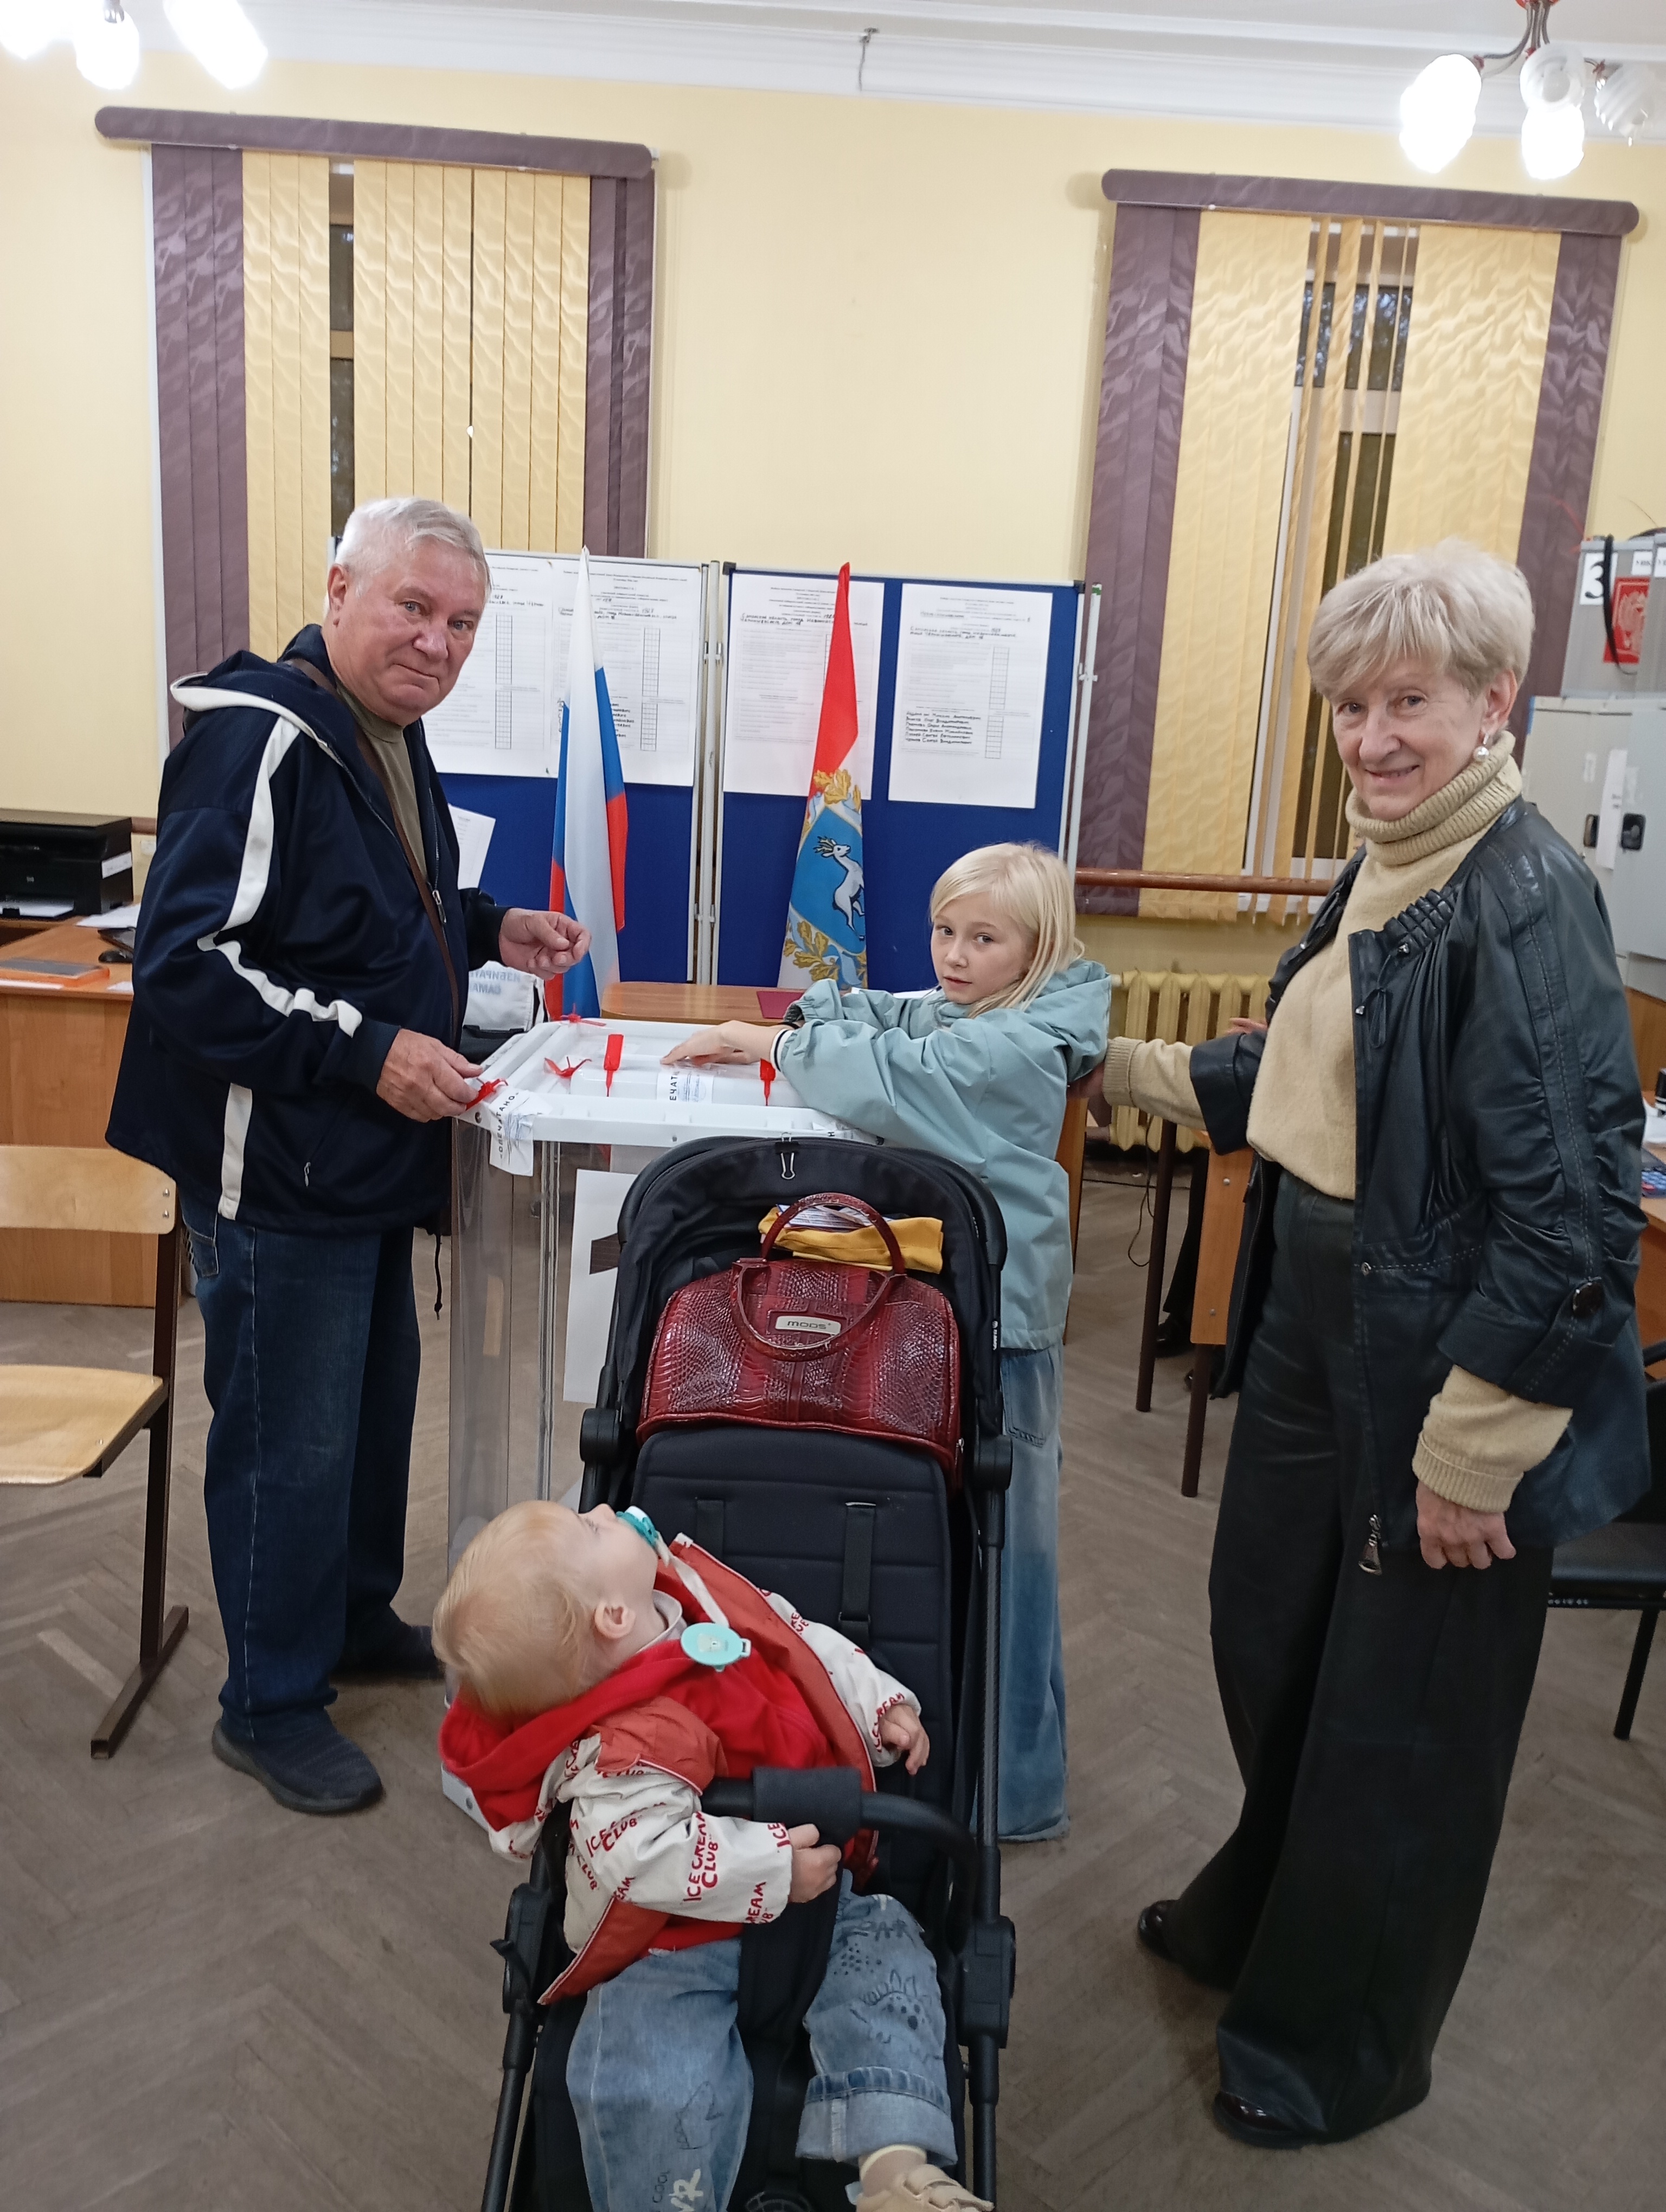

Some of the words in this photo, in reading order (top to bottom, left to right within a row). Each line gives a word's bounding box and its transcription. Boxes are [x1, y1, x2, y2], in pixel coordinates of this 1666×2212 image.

[602, 1818, 638, 1852] CLUB
[767, 1822, 791, 1848] ICE
[701, 1841, 718, 1888] CLUB
[683, 1873, 702, 1902] ICE
